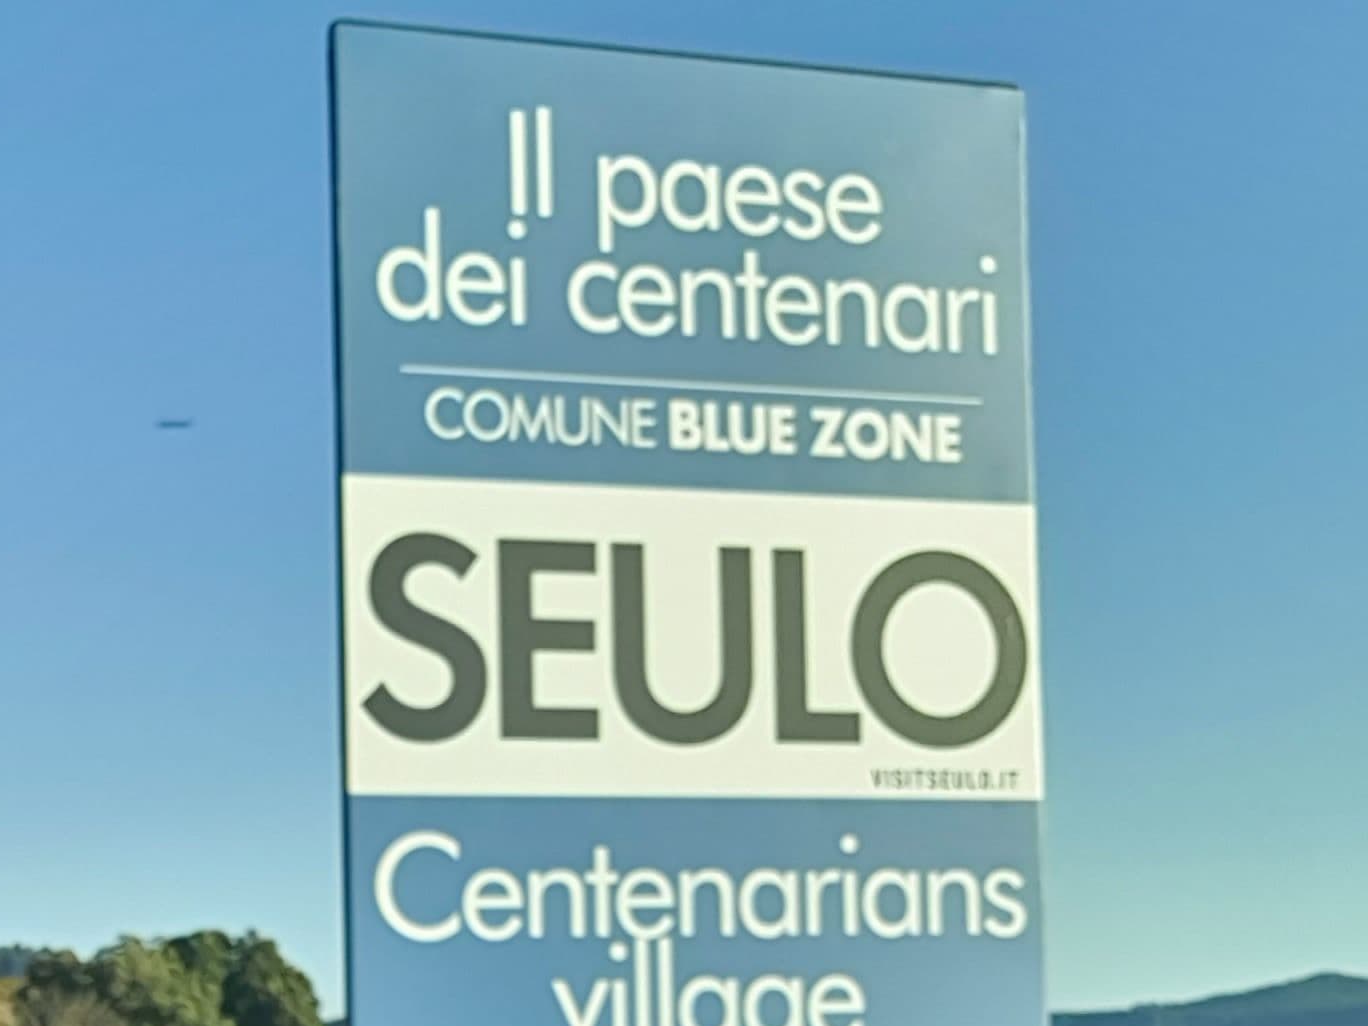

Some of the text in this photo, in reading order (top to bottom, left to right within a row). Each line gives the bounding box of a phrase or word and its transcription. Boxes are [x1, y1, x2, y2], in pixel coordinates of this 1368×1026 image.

[508, 105, 883, 253] Il paese
[376, 206, 999, 356] dei centenari
[424, 386, 964, 464] COMUNE BLUE ZONE
[361, 530, 1028, 750] SEULO
[373, 830, 1029, 943] Centenarians
